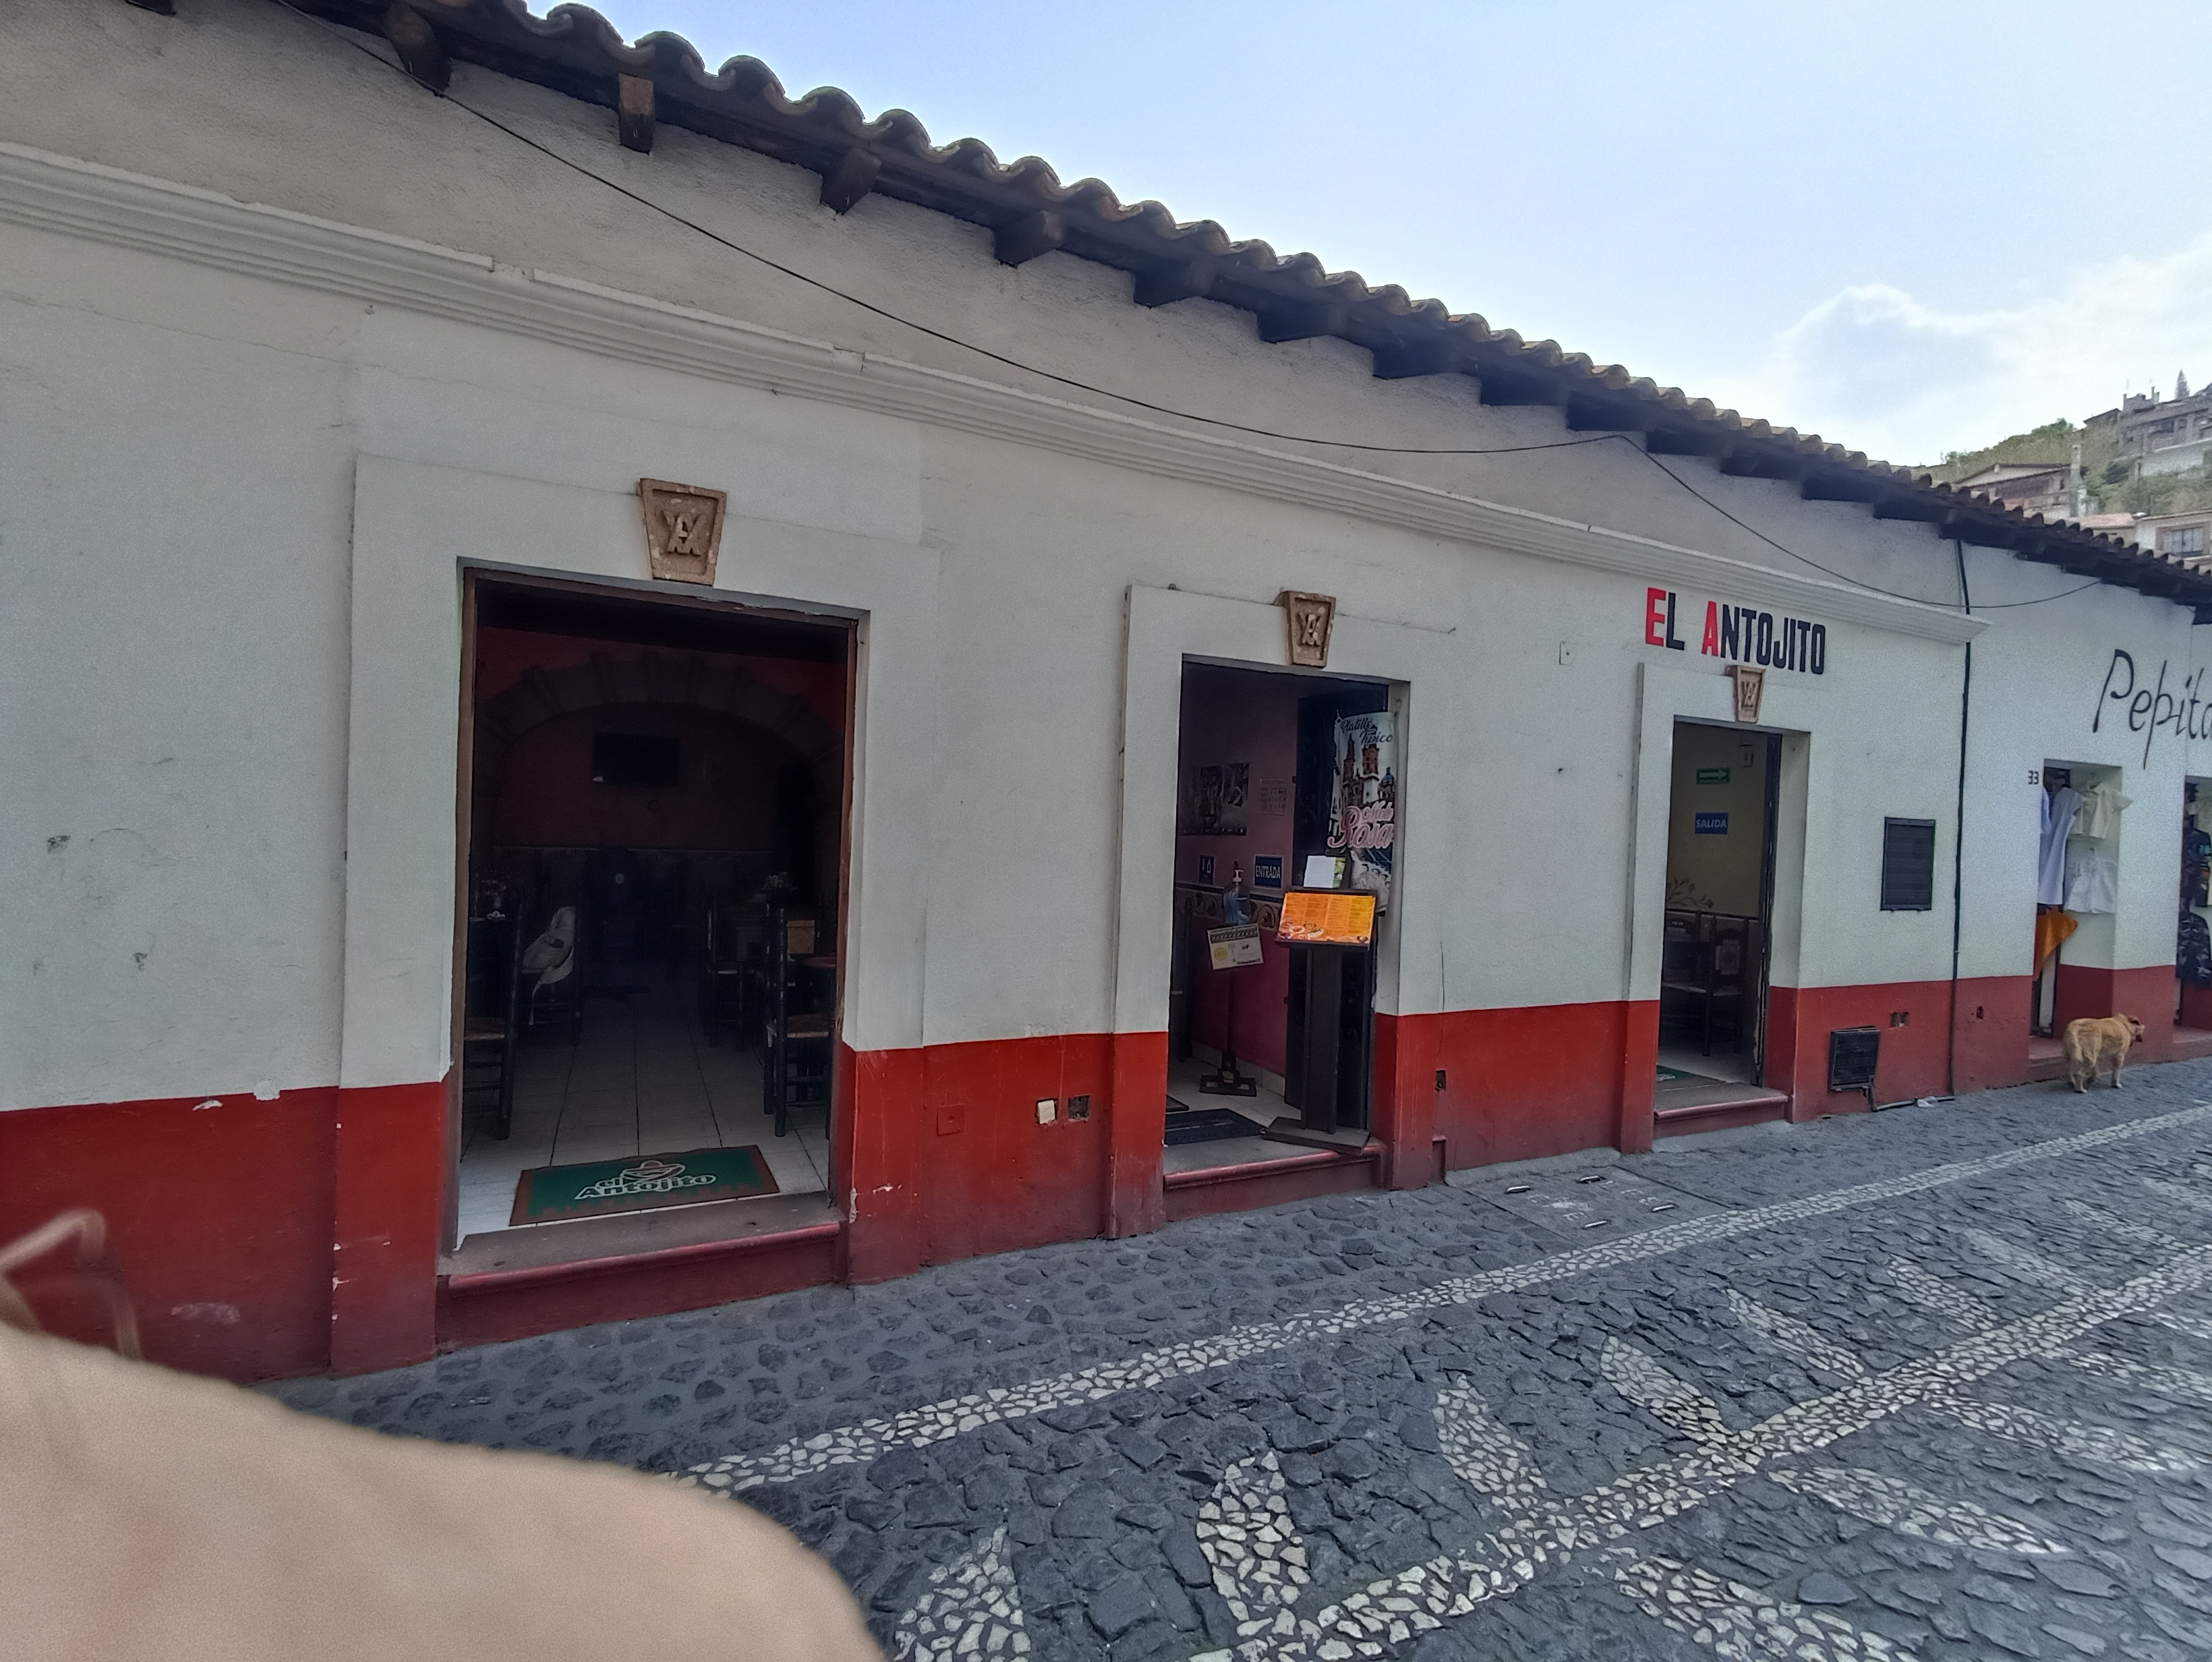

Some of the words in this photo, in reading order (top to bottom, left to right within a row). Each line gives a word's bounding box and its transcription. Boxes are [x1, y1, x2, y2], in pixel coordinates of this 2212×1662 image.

[1645, 587, 1685, 651] EL
[1701, 600, 1826, 675] ANTOJITO
[2028, 770, 2039, 784] 33
[1327, 805, 1393, 849] Rosa
[1696, 819, 1726, 828] SALIDA
[1255, 865, 1281, 880] ENTRADA
[574, 1175, 716, 1200] Antojito
